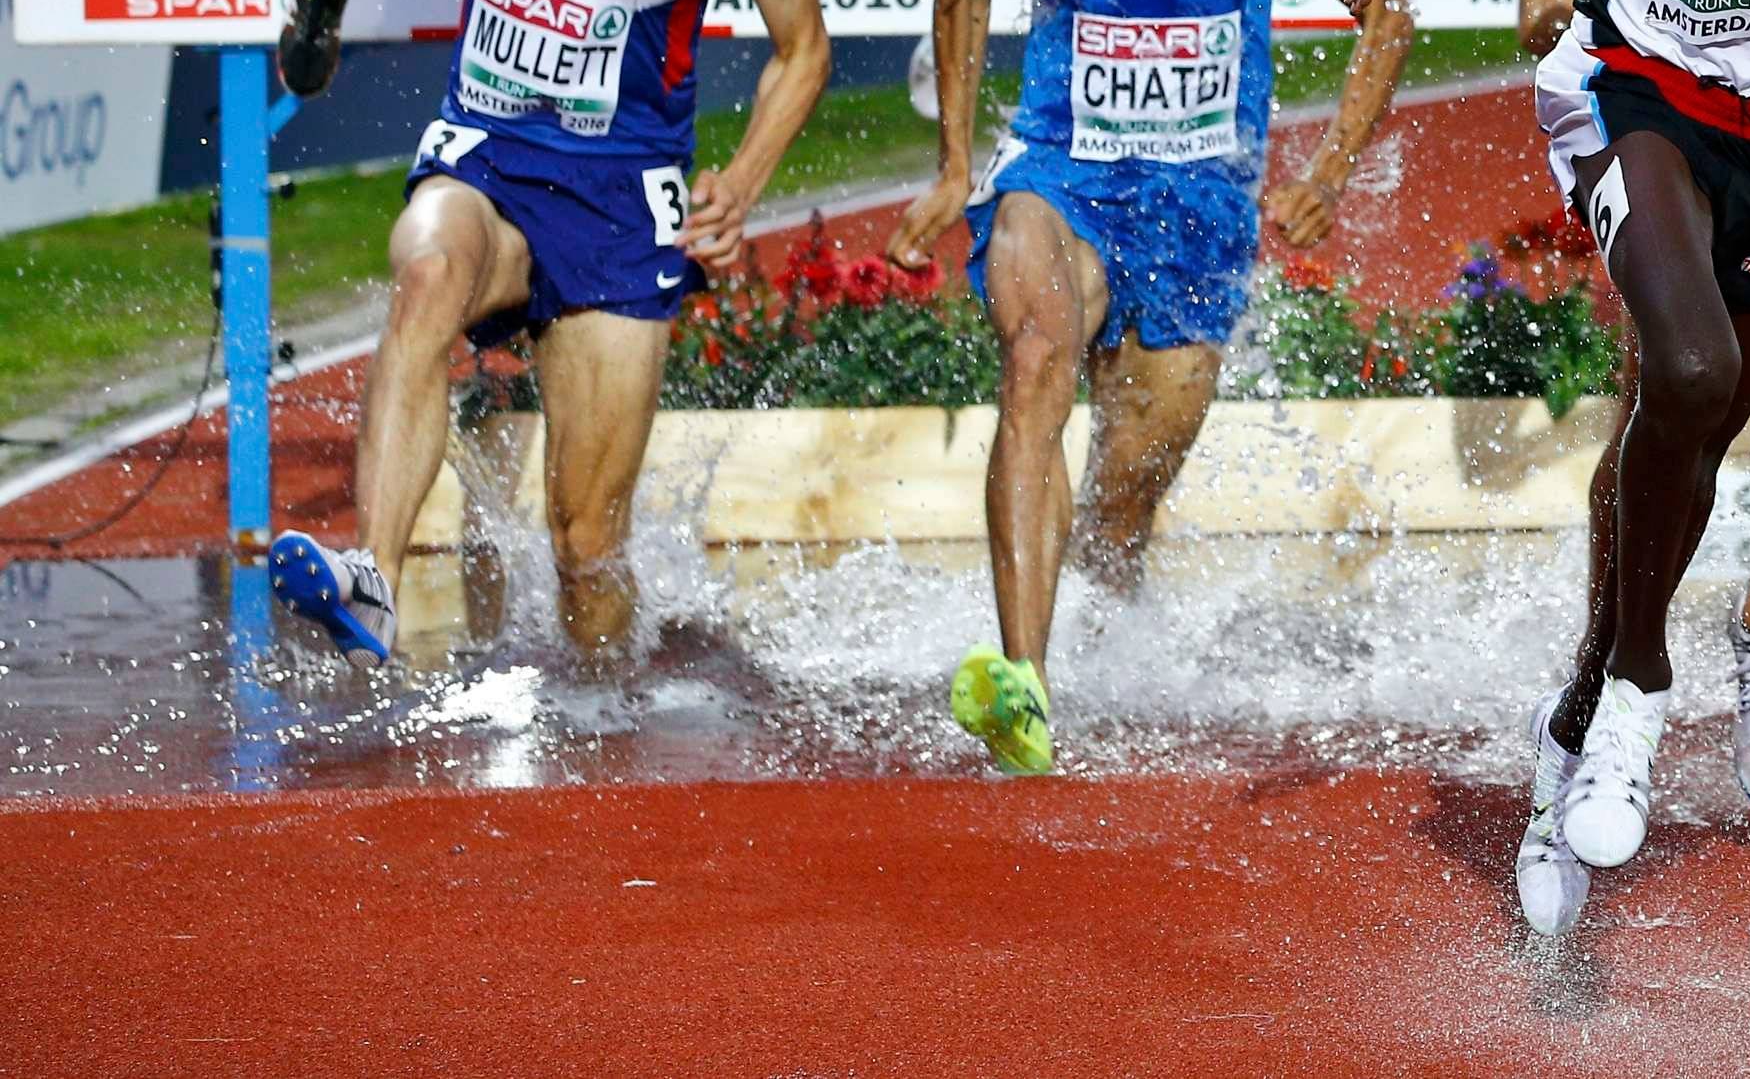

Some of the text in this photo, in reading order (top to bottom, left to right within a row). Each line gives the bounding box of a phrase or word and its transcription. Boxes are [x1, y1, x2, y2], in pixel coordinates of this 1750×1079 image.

[472, 8, 617, 87] MULLETT
[1079, 22, 1200, 58] SPAR
[660, 180, 683, 231] 3
